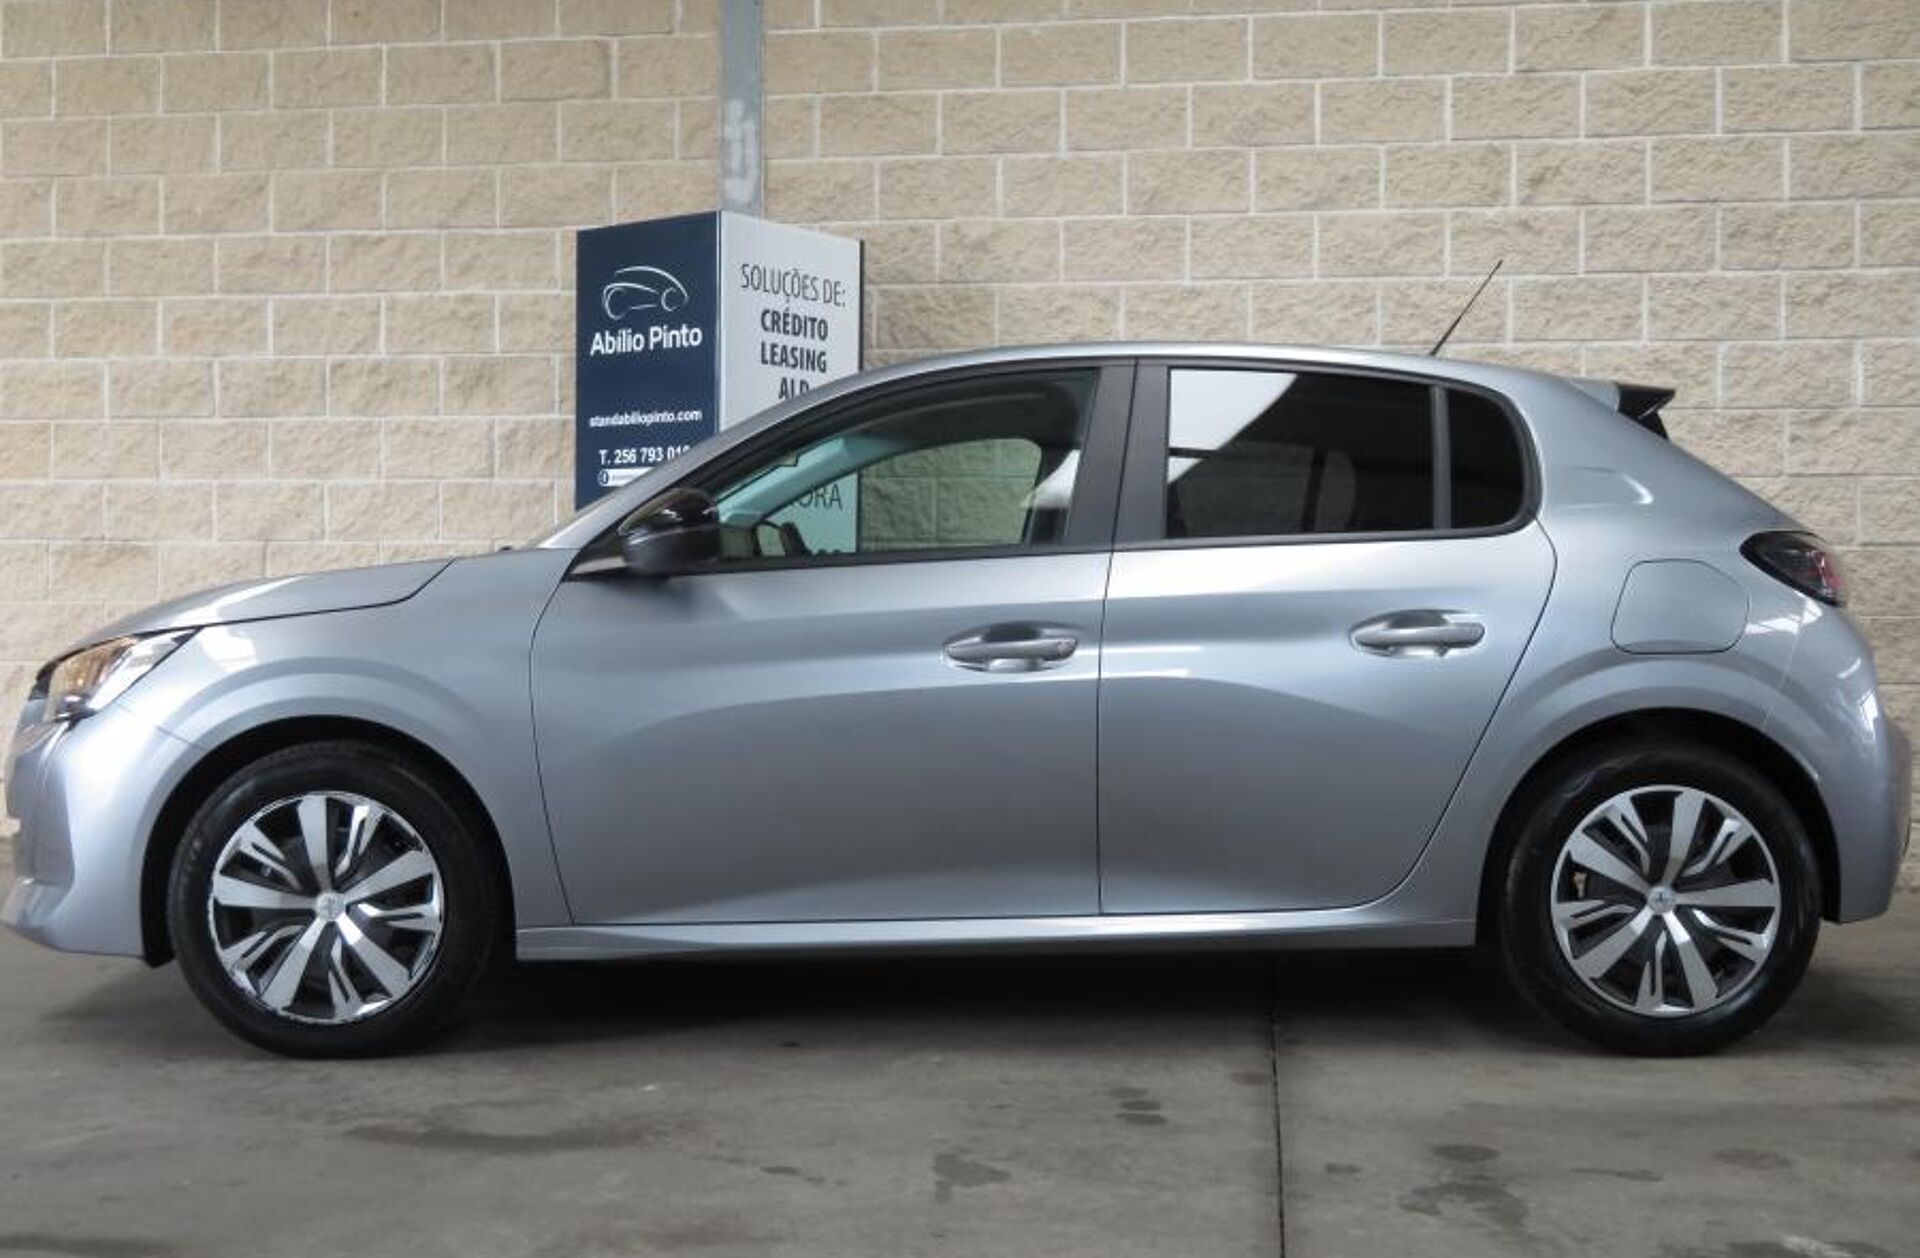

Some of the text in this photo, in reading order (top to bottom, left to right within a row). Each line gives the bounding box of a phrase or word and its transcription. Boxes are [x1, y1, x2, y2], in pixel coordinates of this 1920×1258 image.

[740, 263, 846, 307] SOLUÇÕES DE:
[649, 323, 703, 351] Pinto
[760, 306, 829, 341] CRÉDITO
[760, 341, 828, 374] LEASING
[599, 449, 611, 465] T.
[613, 448, 637, 464] 256
[640, 446, 664, 463] 793
